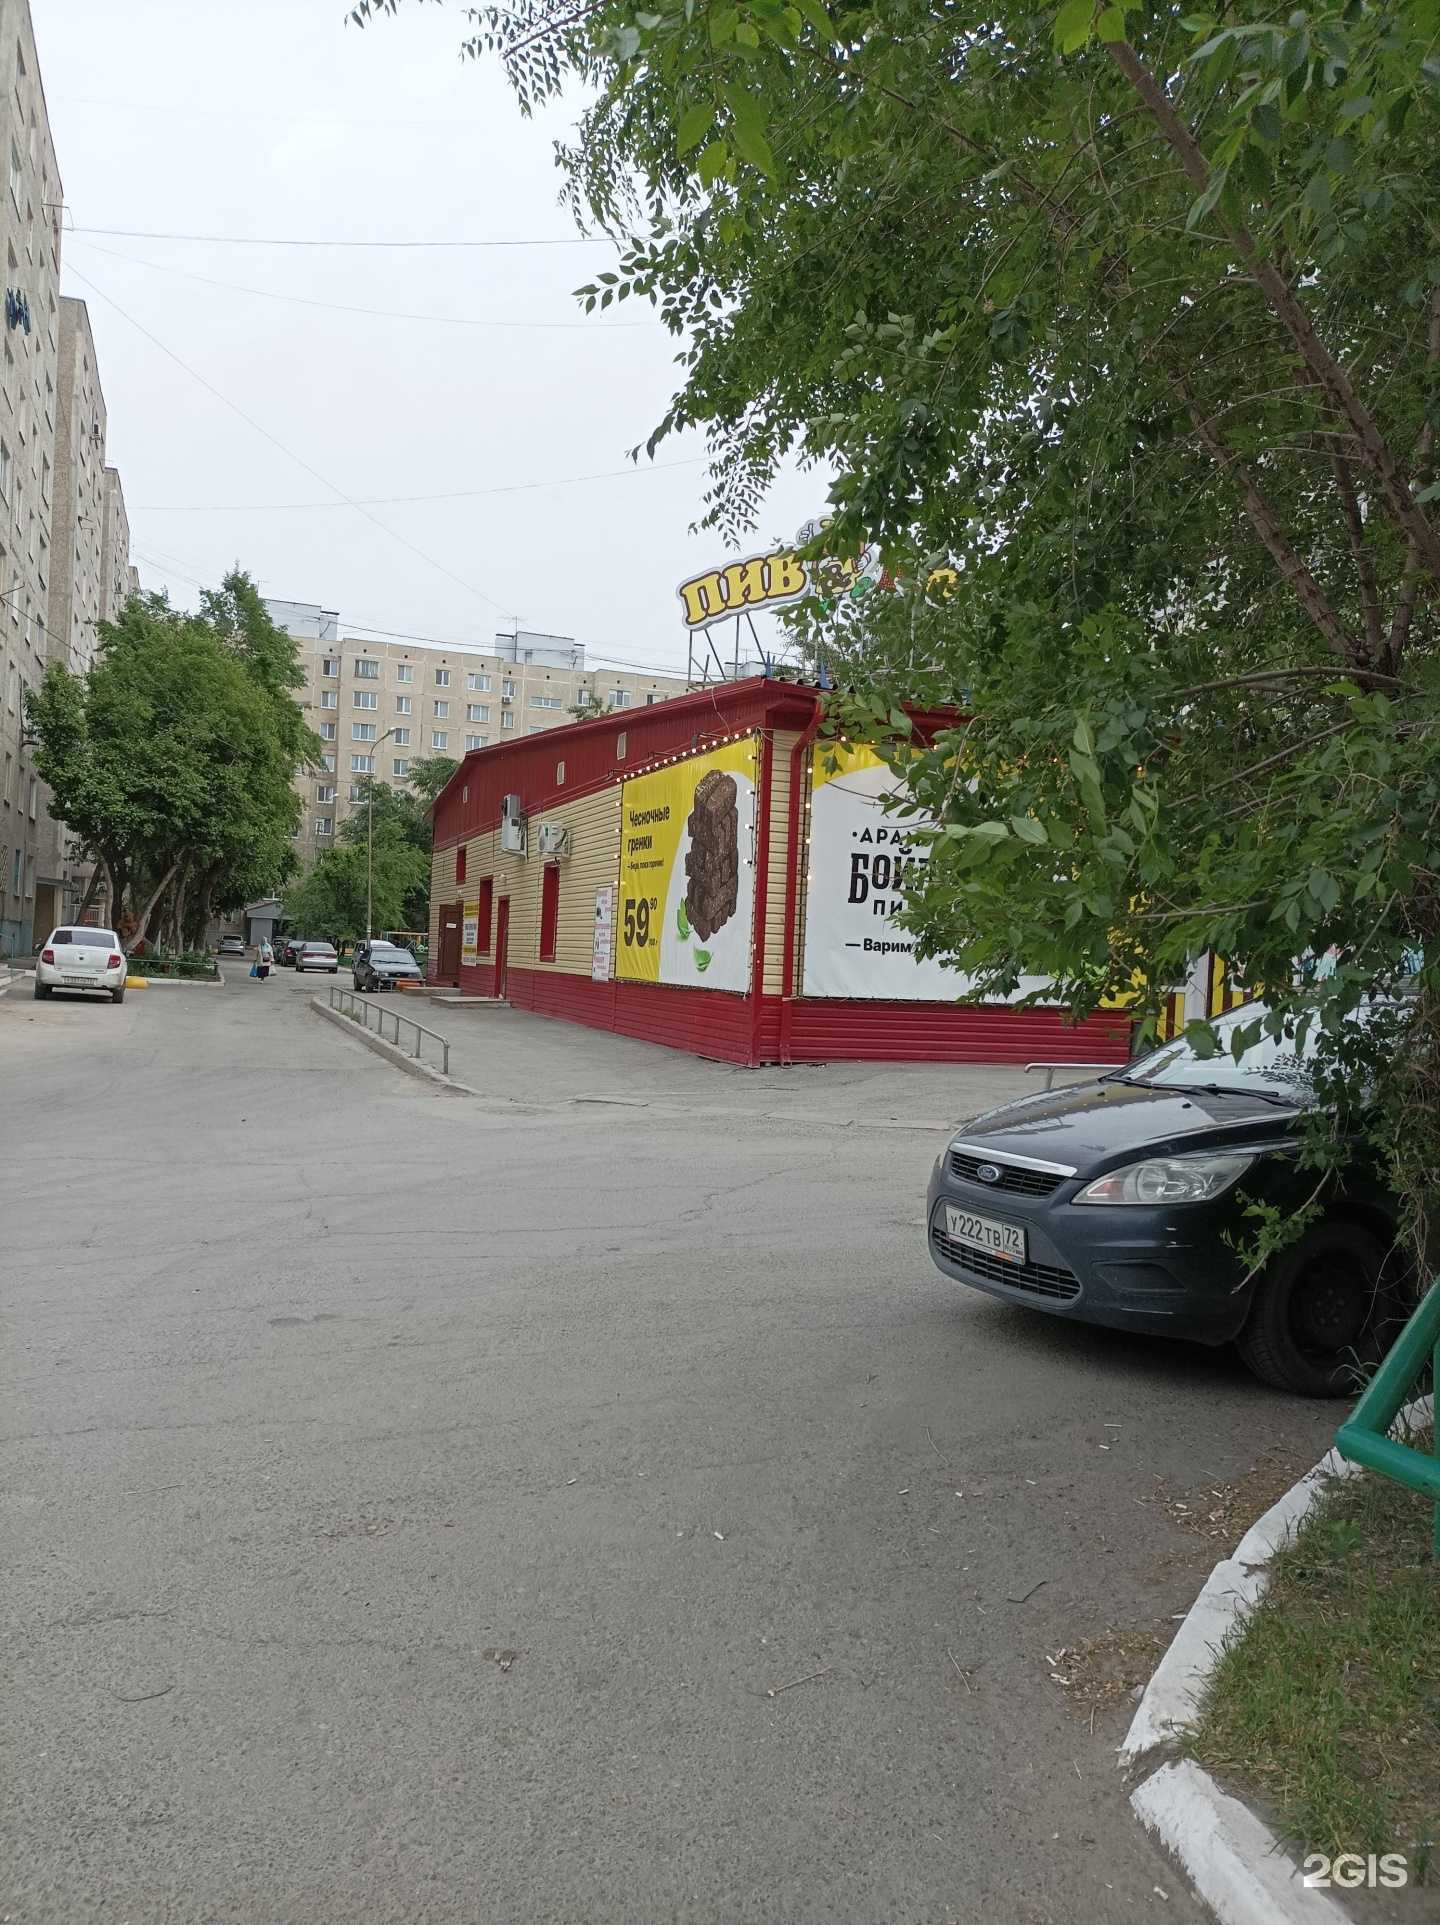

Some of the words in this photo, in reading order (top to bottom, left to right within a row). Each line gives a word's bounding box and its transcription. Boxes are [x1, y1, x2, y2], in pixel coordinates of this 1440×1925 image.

[629, 806, 670, 828] Чесночные
[627, 835, 653, 856] гренки
[860, 828, 920, 847] АРА
[848, 848, 930, 904] БОЙ
[624, 898, 650, 948] 59
[650, 896, 658, 911] 90
[863, 938, 912, 955] Варим
